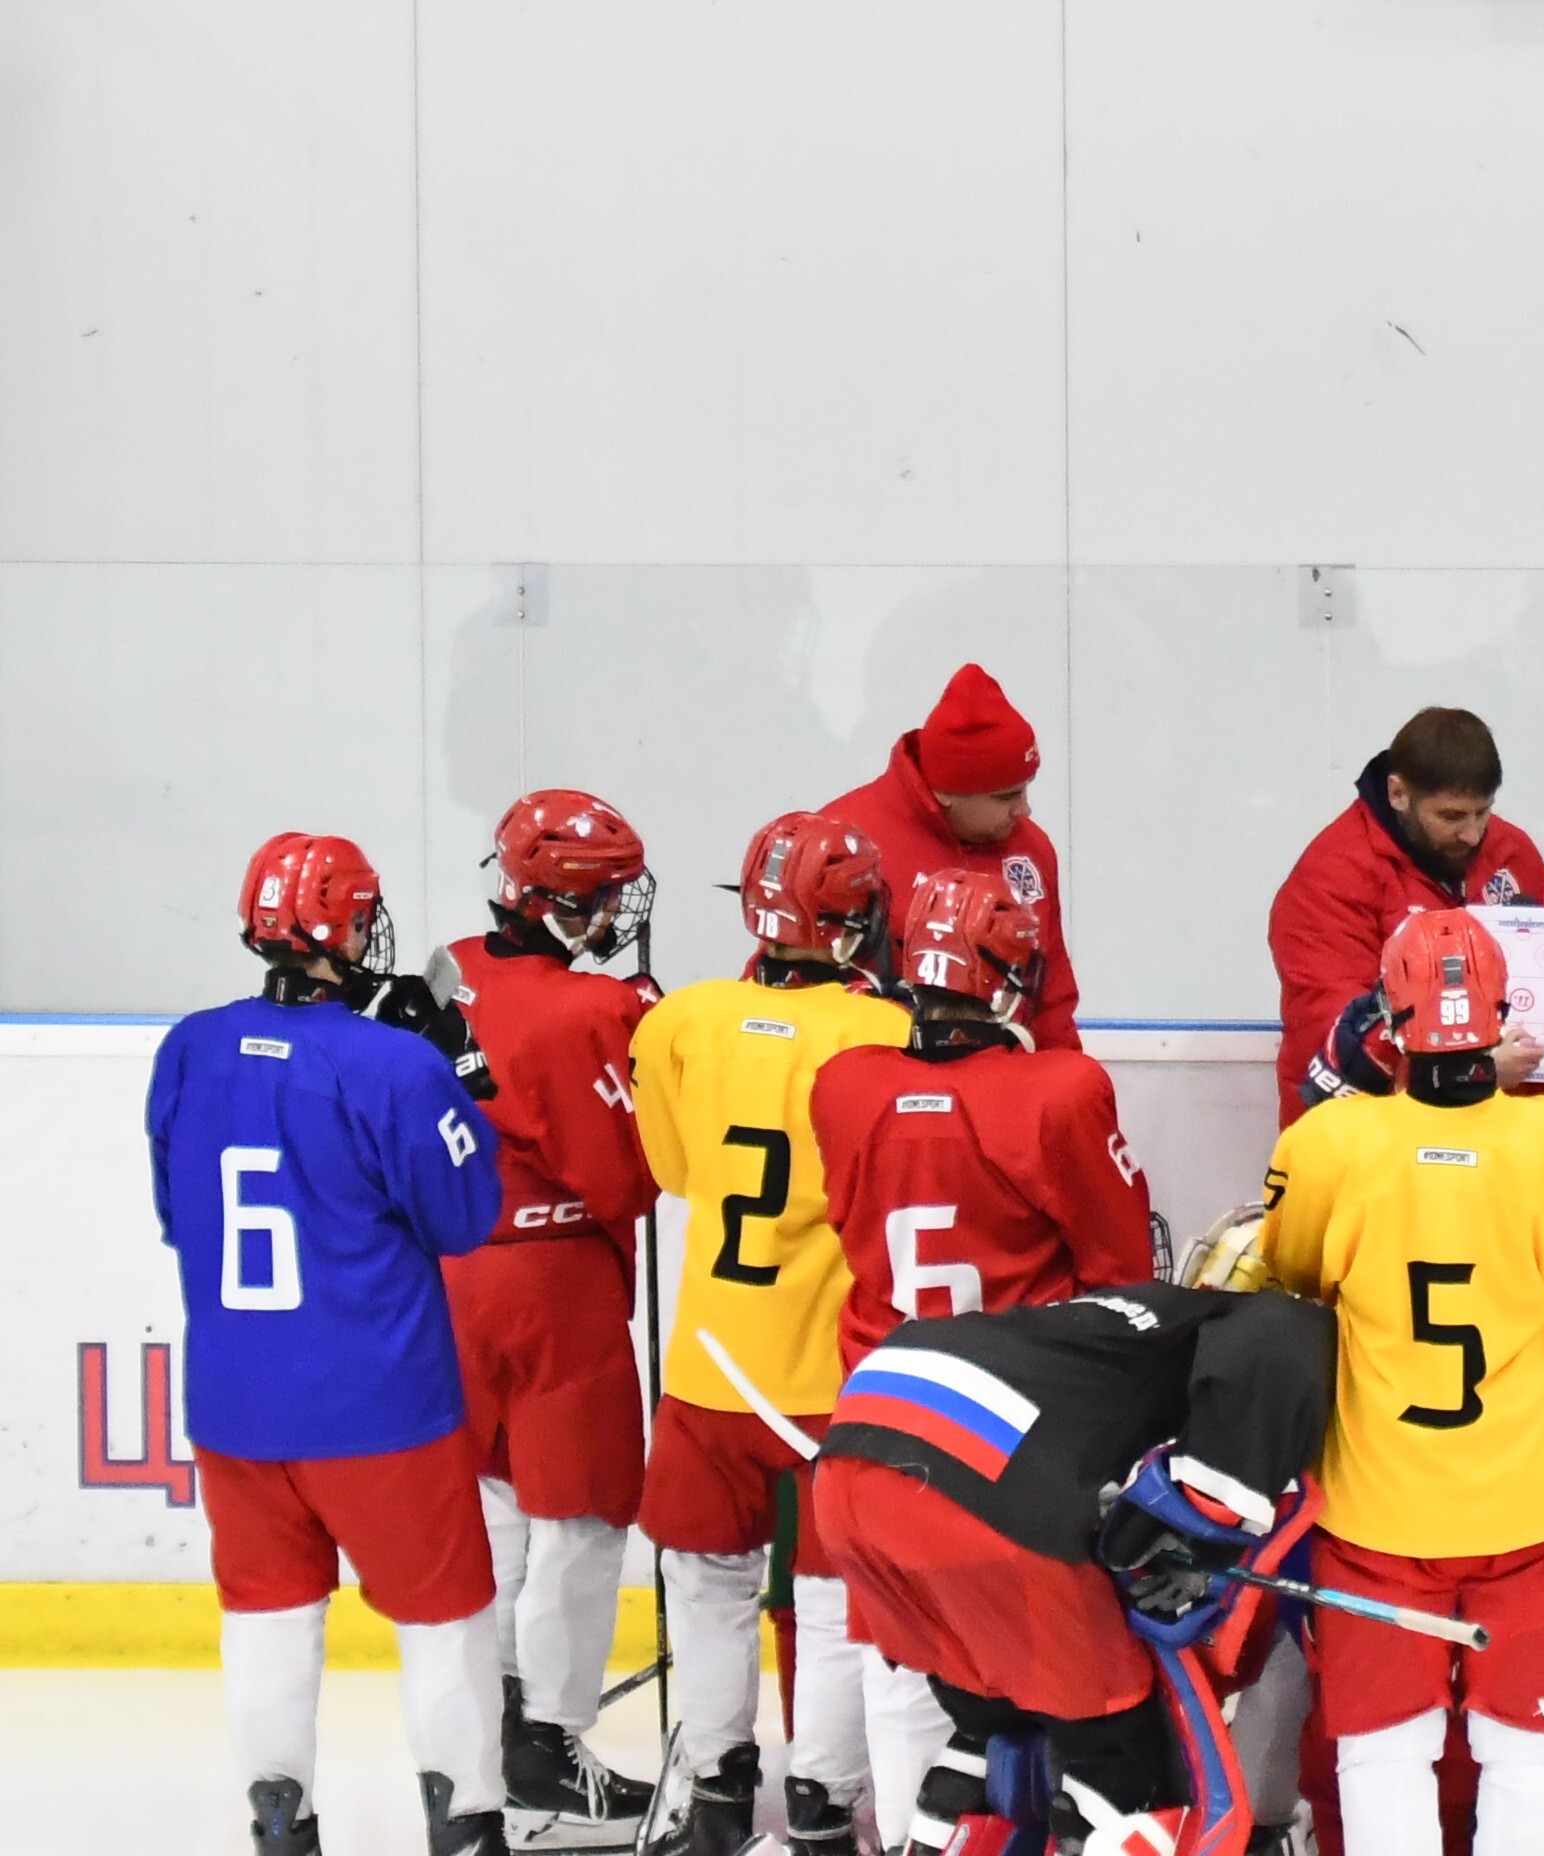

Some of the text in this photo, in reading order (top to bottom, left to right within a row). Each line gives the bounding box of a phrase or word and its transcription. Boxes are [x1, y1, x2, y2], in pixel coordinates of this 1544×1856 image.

[1441, 998, 1470, 1026] 99
[438, 1107, 477, 1168] 6
[219, 1146, 302, 1310] 6
[513, 1201, 593, 1229] CC
[711, 1125, 791, 1286] 2
[1397, 1260, 1487, 1430] 5
